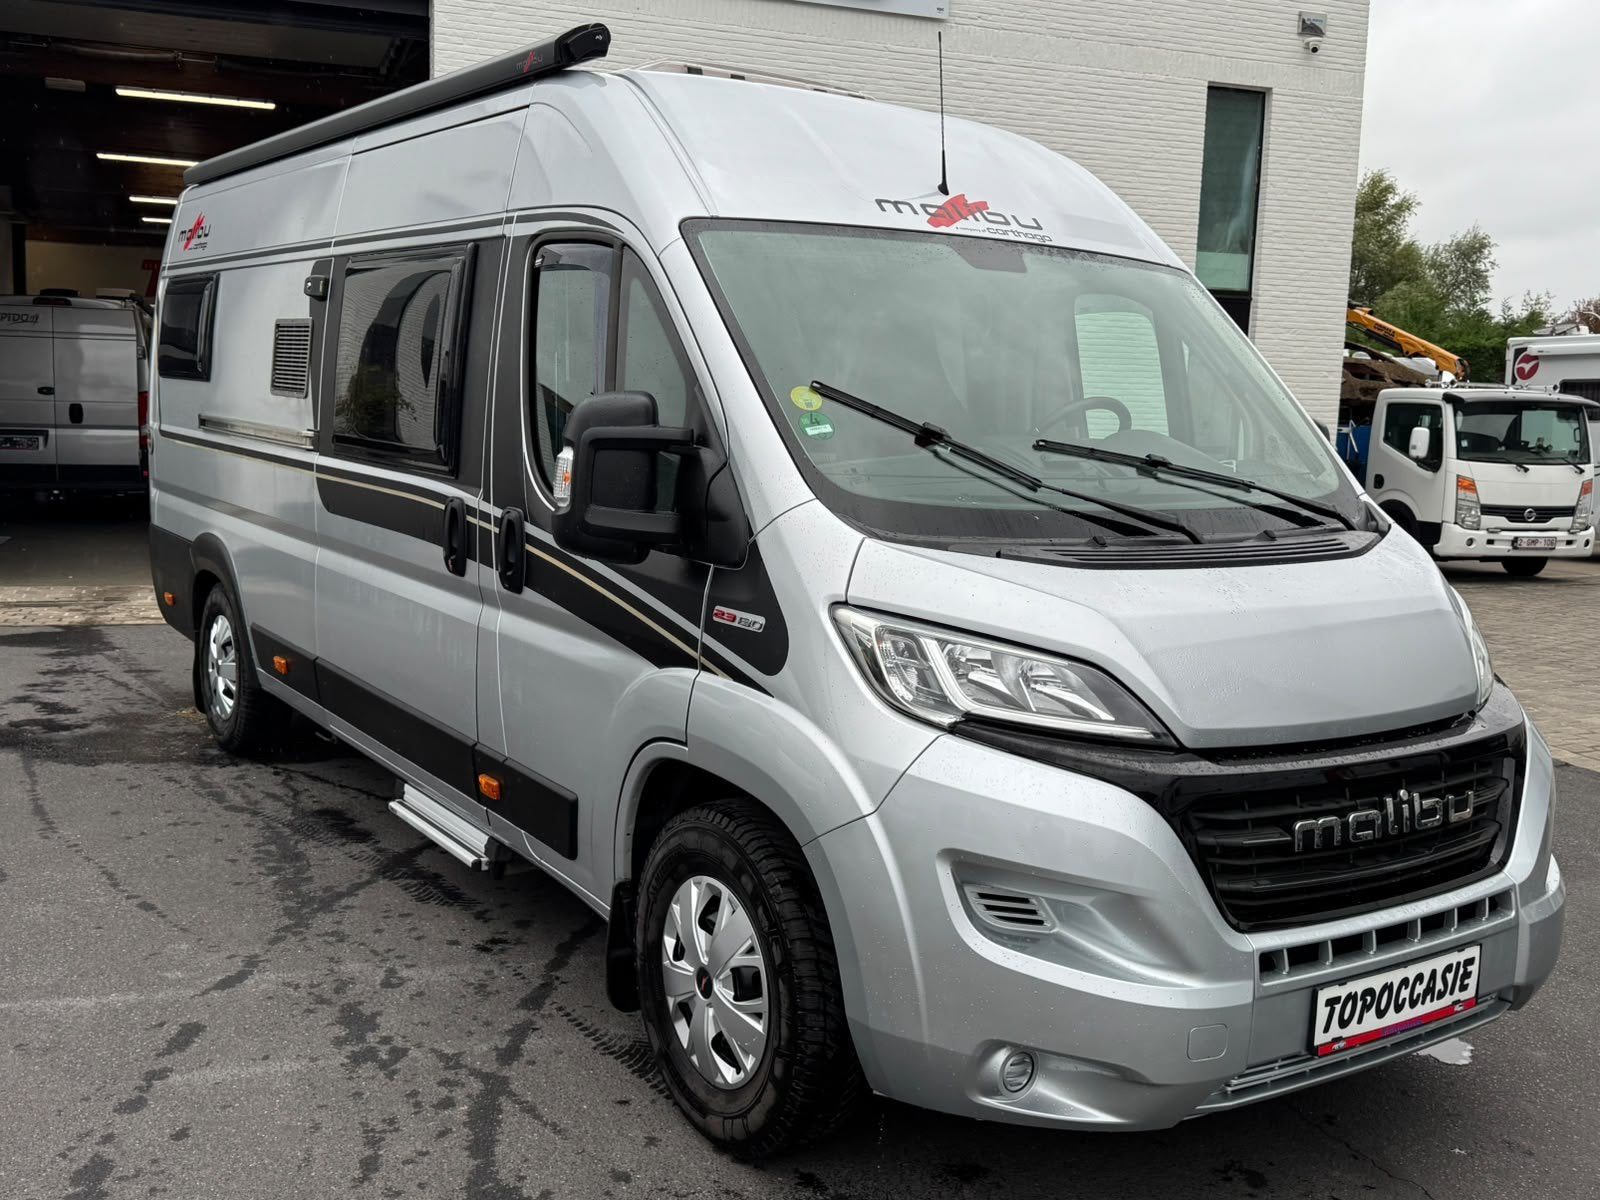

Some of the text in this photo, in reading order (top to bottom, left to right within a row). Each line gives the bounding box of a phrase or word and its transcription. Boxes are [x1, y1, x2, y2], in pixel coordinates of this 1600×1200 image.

[874, 199, 1043, 231] malibu
[986, 226, 1053, 243] carthago
[1295, 789, 1475, 852] malibu
[1322, 956, 1476, 1034] TOPOCCASIE
